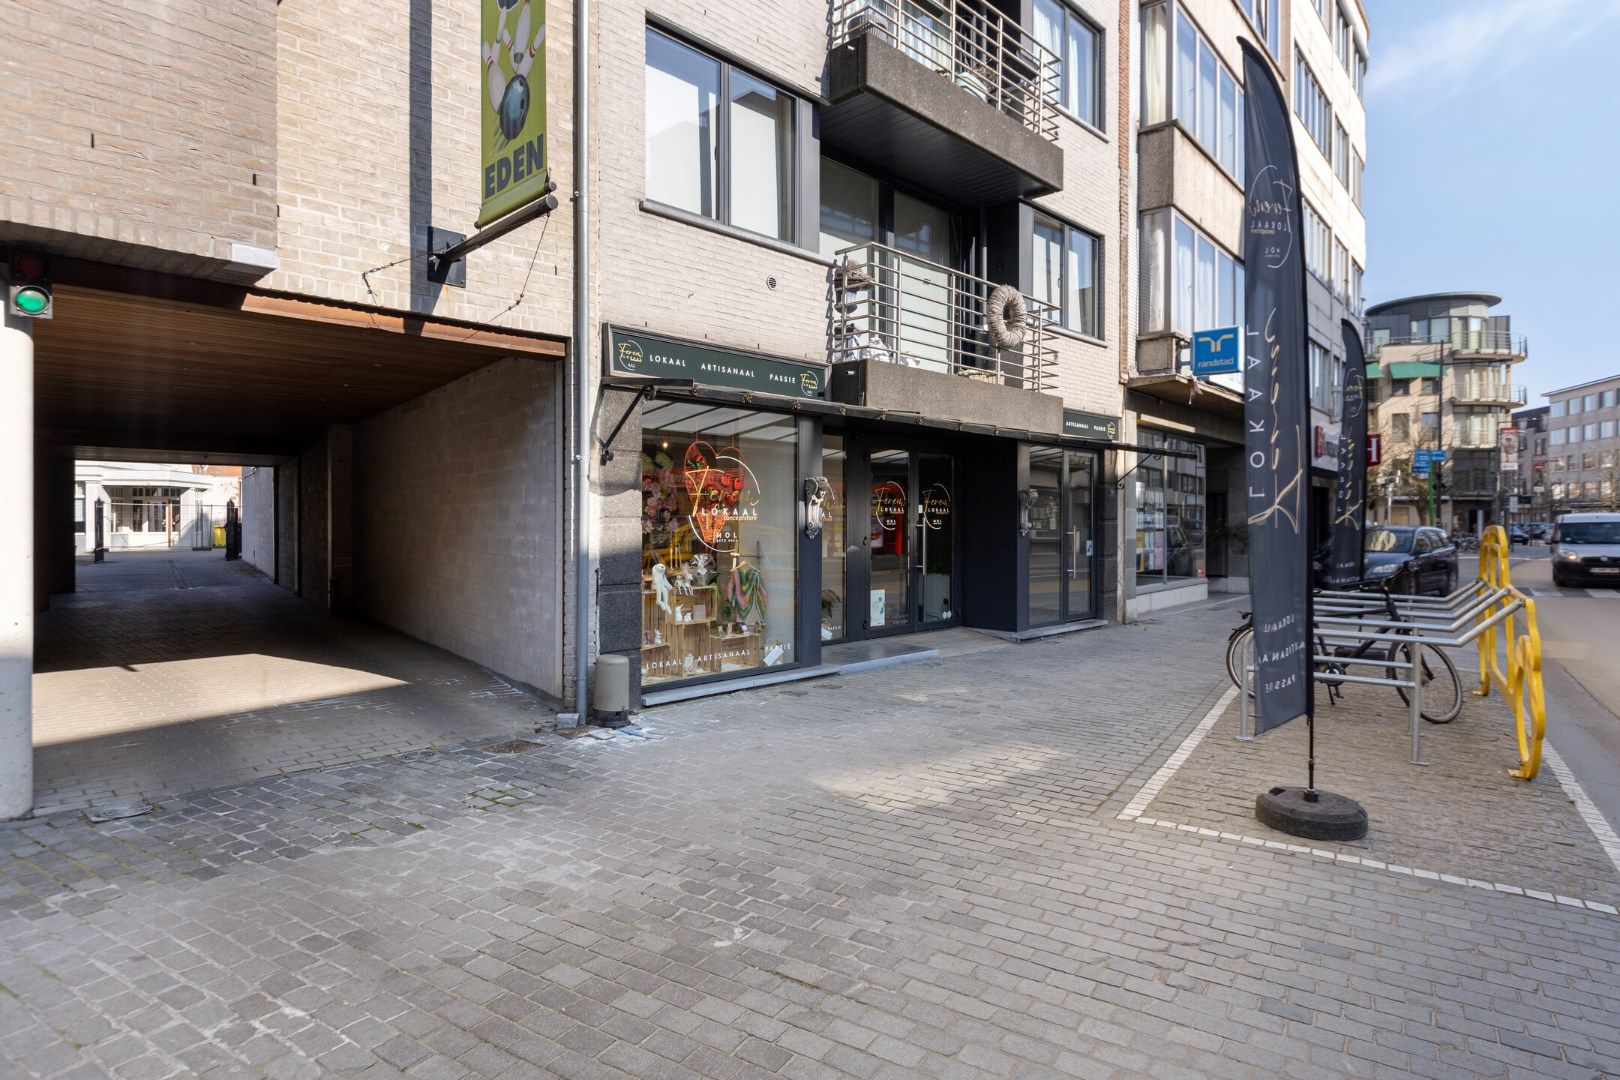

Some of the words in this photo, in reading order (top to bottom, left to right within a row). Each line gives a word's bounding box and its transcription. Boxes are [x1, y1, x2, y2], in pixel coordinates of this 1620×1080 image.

[484, 133, 545, 200] EDEN
[649, 354, 687, 367] LOKAAL
[701, 363, 755, 378] ARTISANAAL
[769, 373, 797, 384] PASSIE
[1198, 357, 1234, 368] randstad
[701, 507, 758, 516] LOKAAL
[646, 659, 682, 670] LOKAAL
[697, 649, 751, 662] ARTISANAAL
